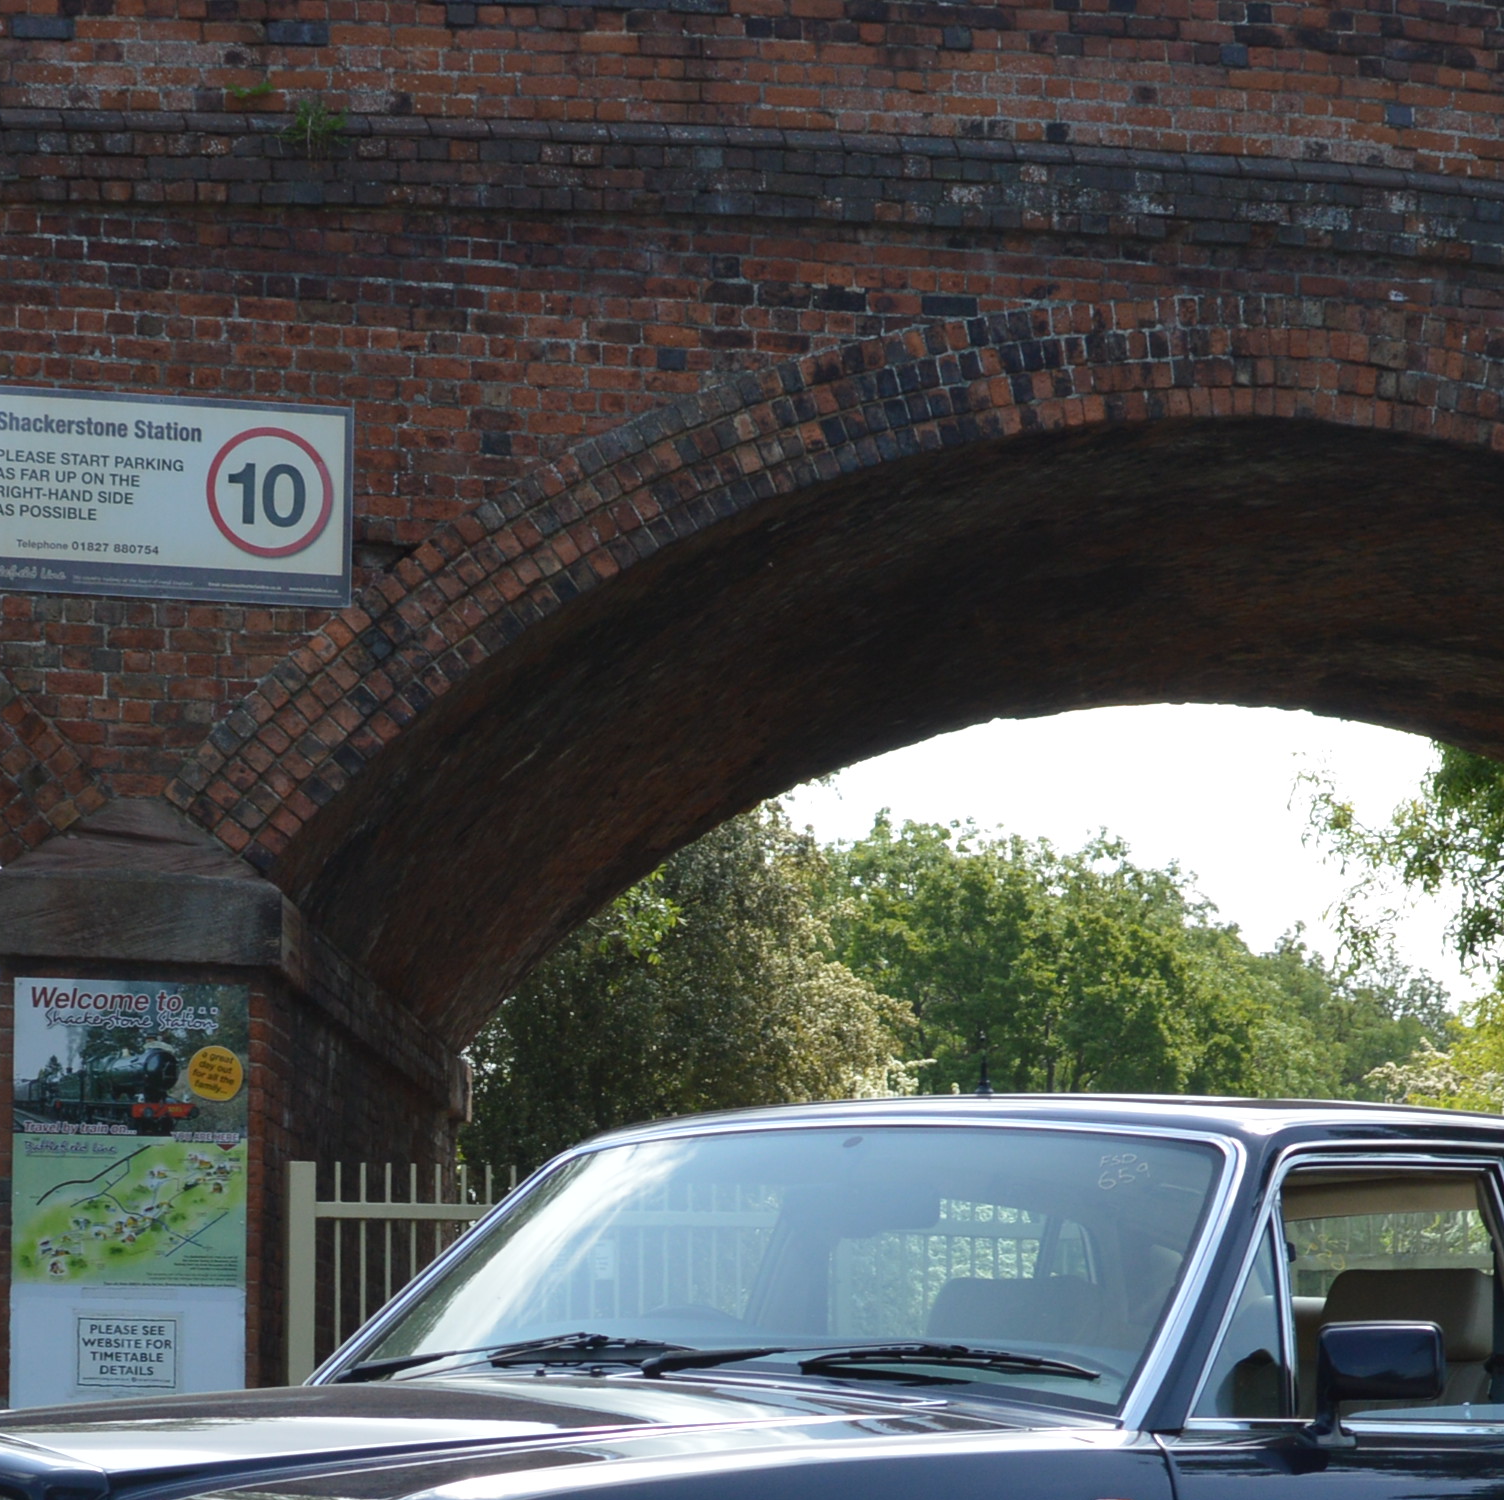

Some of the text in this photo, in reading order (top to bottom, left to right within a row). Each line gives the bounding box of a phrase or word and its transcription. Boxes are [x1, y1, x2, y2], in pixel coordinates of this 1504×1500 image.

[134, 419, 202, 442] Station
[60, 452, 110, 468] START
[114, 454, 184, 472] PARKING
[20, 468, 51, 483] FAR
[55, 470, 77, 484] UP
[82, 471, 105, 485] ON
[109, 473, 140, 488] THE
[97, 489, 134, 505] SIDE
[228, 462, 306, 528] 10
[20, 505, 97, 521] POSSIBLE
[16, 538, 159, 555] Telephone 01827 880754
[31, 986, 150, 1011] Welcome
[45, 1008, 218, 1031] Shackerstone Station
[209, 1053, 234, 1064] great
[198, 1061, 232, 1074] day out
[192, 1068, 234, 1086] for all the
[24, 1120, 61, 1133] Travel
[62, 1120, 79, 1135] by
[80, 1122, 109, 1134] train
[193, 1132, 213, 1142] ARE
[214, 1132, 240, 1142] HERE
[89, 1324, 165, 1336] PLEASE SEE
[82, 1337, 172, 1350] WEBSITE FOR
[90, 1351, 164, 1362] TIMETABLE
[99, 1365, 154, 1376] DETAILS
